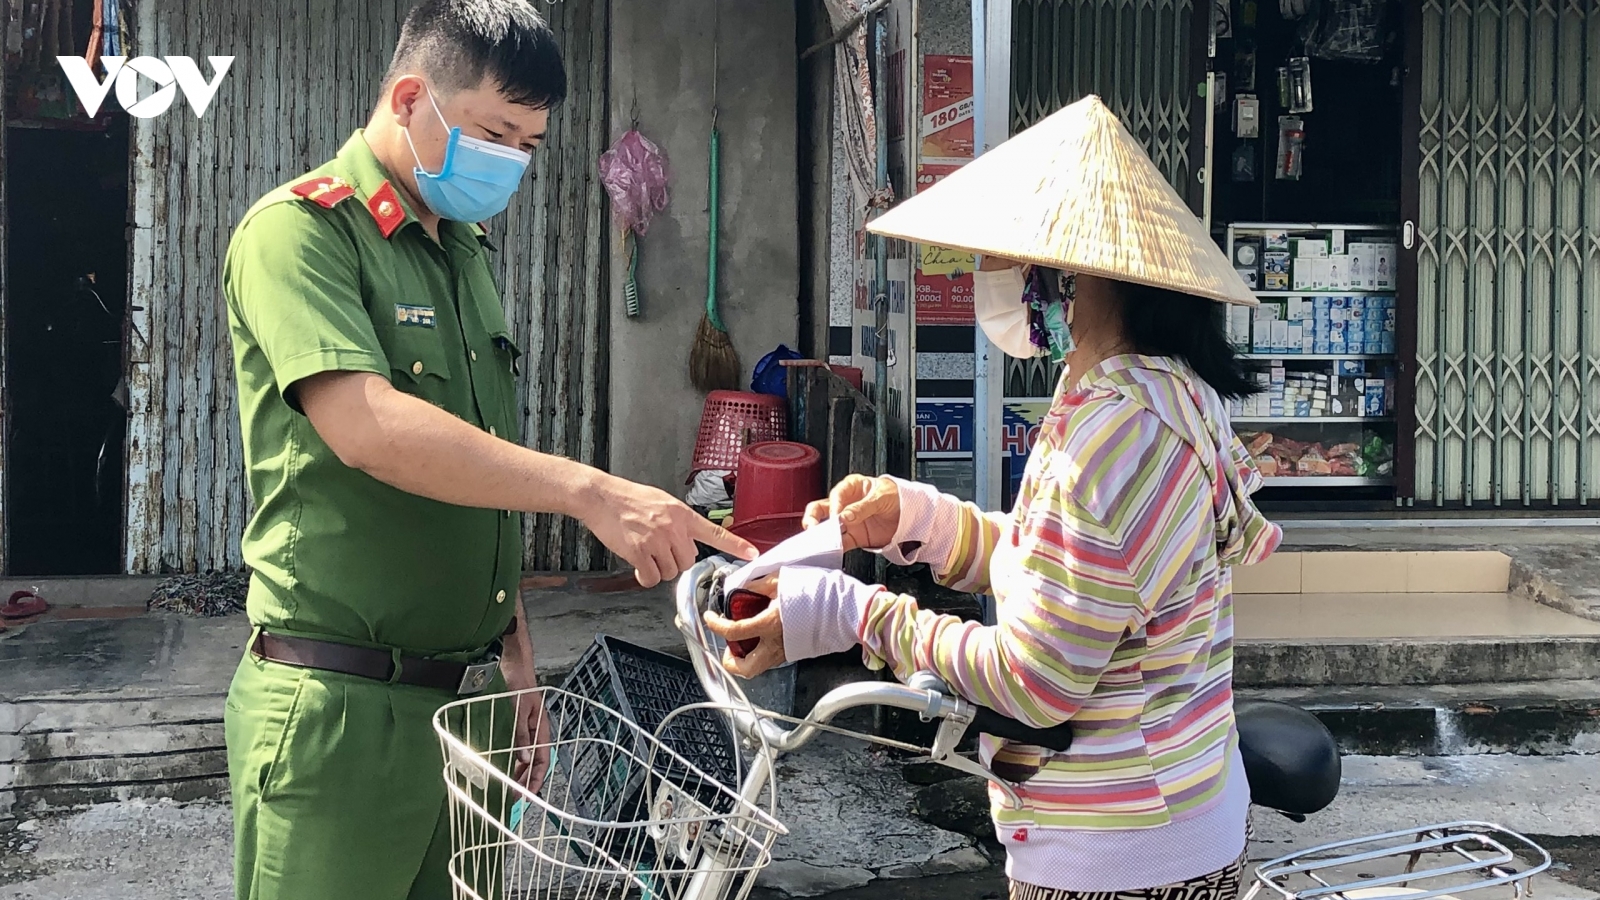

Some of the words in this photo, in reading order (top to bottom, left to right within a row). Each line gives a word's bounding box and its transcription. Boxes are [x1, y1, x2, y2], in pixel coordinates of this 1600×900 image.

[930, 107, 958, 129] 180
[965, 253, 976, 264] S
[951, 285, 964, 294] 4G
[951, 295, 974, 303] 90.00
[915, 425, 960, 452] IM
